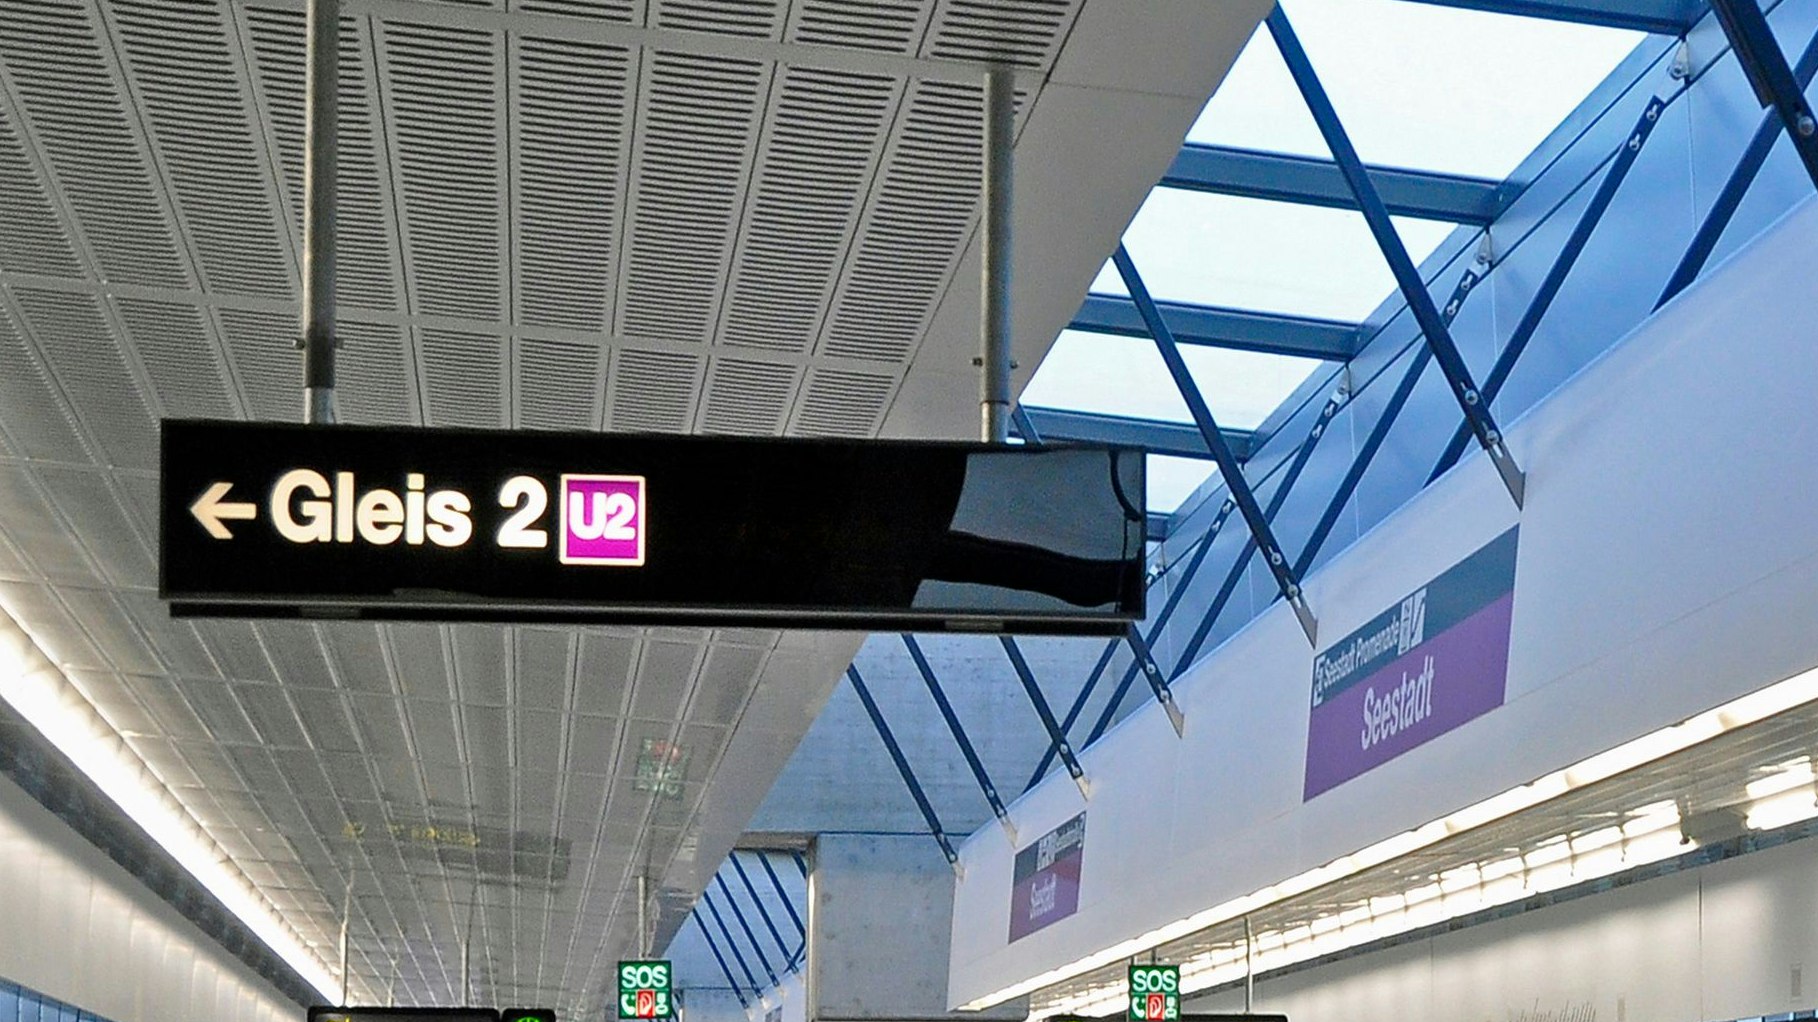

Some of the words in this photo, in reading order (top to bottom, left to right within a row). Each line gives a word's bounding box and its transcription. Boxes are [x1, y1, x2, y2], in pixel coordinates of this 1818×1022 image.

[270, 468, 474, 548] Gleis
[496, 475, 548, 548] 2
[567, 491, 637, 540] U2
[1324, 643, 1356, 688] Seestadt
[1356, 615, 1400, 669] Promenade
[1361, 655, 1435, 750] Seestadt
[621, 965, 668, 989] SOS
[1132, 969, 1177, 992] SOS
